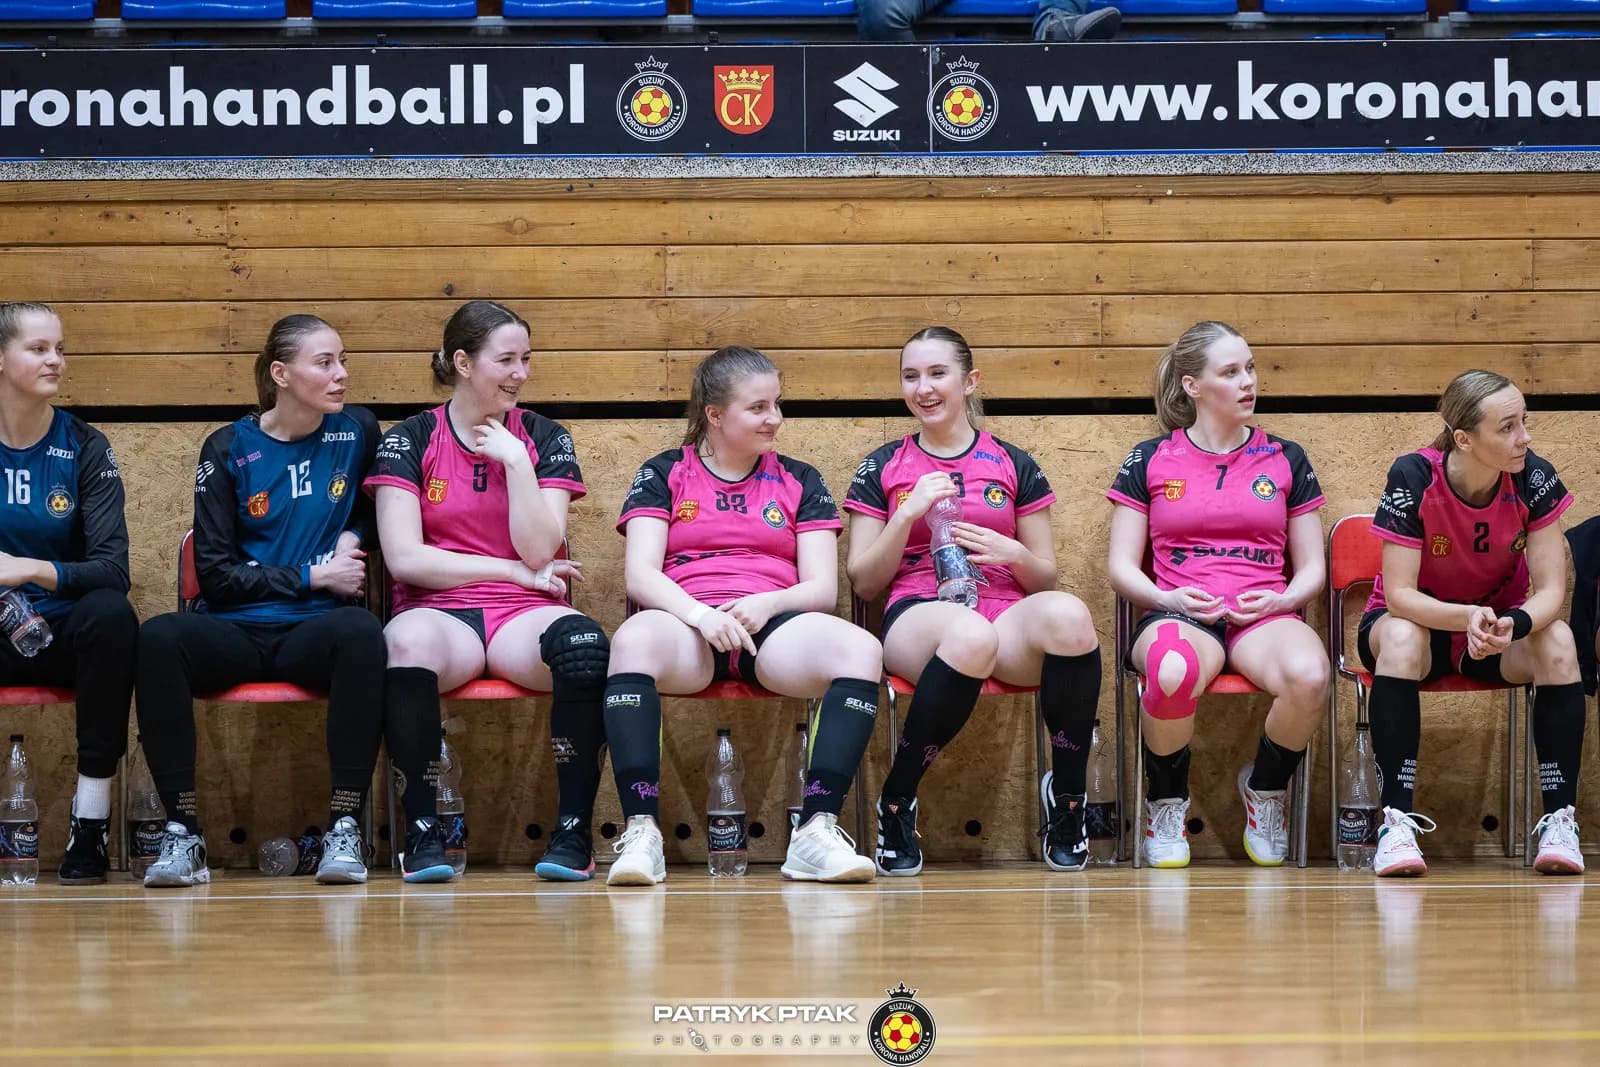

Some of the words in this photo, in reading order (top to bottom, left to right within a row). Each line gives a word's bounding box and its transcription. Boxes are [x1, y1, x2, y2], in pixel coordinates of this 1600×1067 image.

[638, 76, 665, 87] SUZUKI
[949, 76, 977, 87] SUZUKI
[0, 64, 585, 145] ronahandball.pl
[720, 92, 762, 126] CK
[623, 111, 649, 136] KORONA
[649, 111, 681, 136] HANDBALL
[935, 111, 960, 136] KORONA
[960, 111, 992, 136] HANDBALL
[832, 129, 900, 141] SUZUKI
[4, 468, 31, 505] 16
[287, 459, 313, 499] 12
[473, 463, 488, 492] 5
[1215, 464, 1229, 490] 7
[426, 486, 444, 502] CK
[1166, 487, 1181, 499] CK
[678, 508, 695, 521] CK
[1473, 522, 1490, 553] 2
[1192, 545, 1276, 565] SUZUKI
[1432, 543, 1448, 556] CK
[570, 632, 598, 643] SELECT
[606, 693, 641, 704] SELECT
